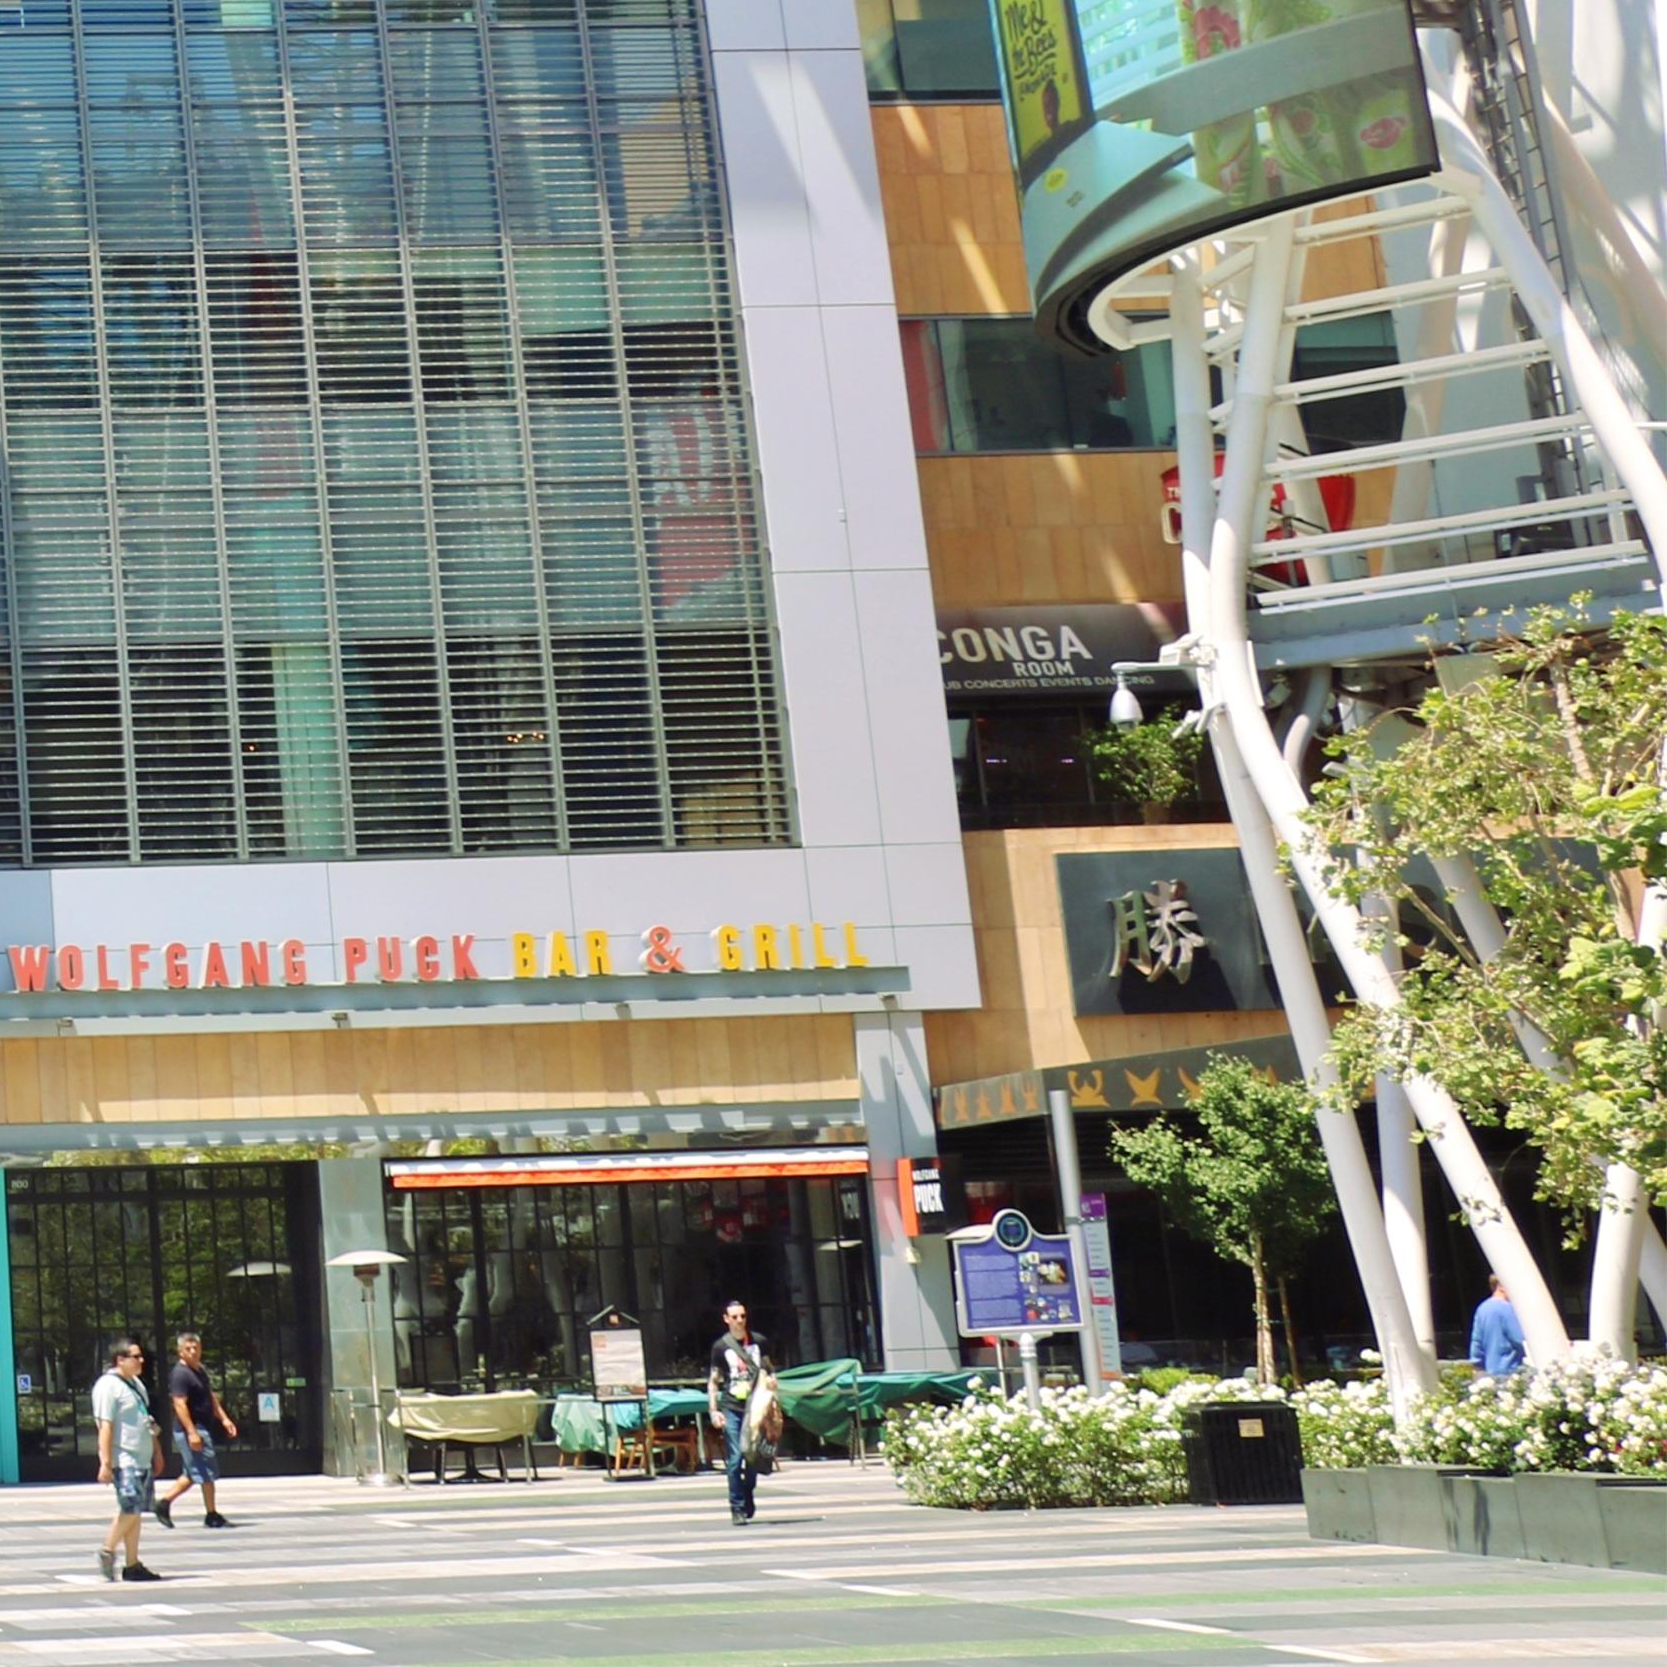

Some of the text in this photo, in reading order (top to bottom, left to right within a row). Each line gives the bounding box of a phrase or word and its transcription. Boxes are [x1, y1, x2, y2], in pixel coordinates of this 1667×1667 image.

[1012, 661, 1075, 677] ROOM
[964, 678, 1038, 690] CONCERTS
[1042, 676, 1091, 688] EVENTS
[7, 920, 871, 993] WOLFGANG PUCK BAR & GRILL
[913, 1183, 945, 1214] PUCK
